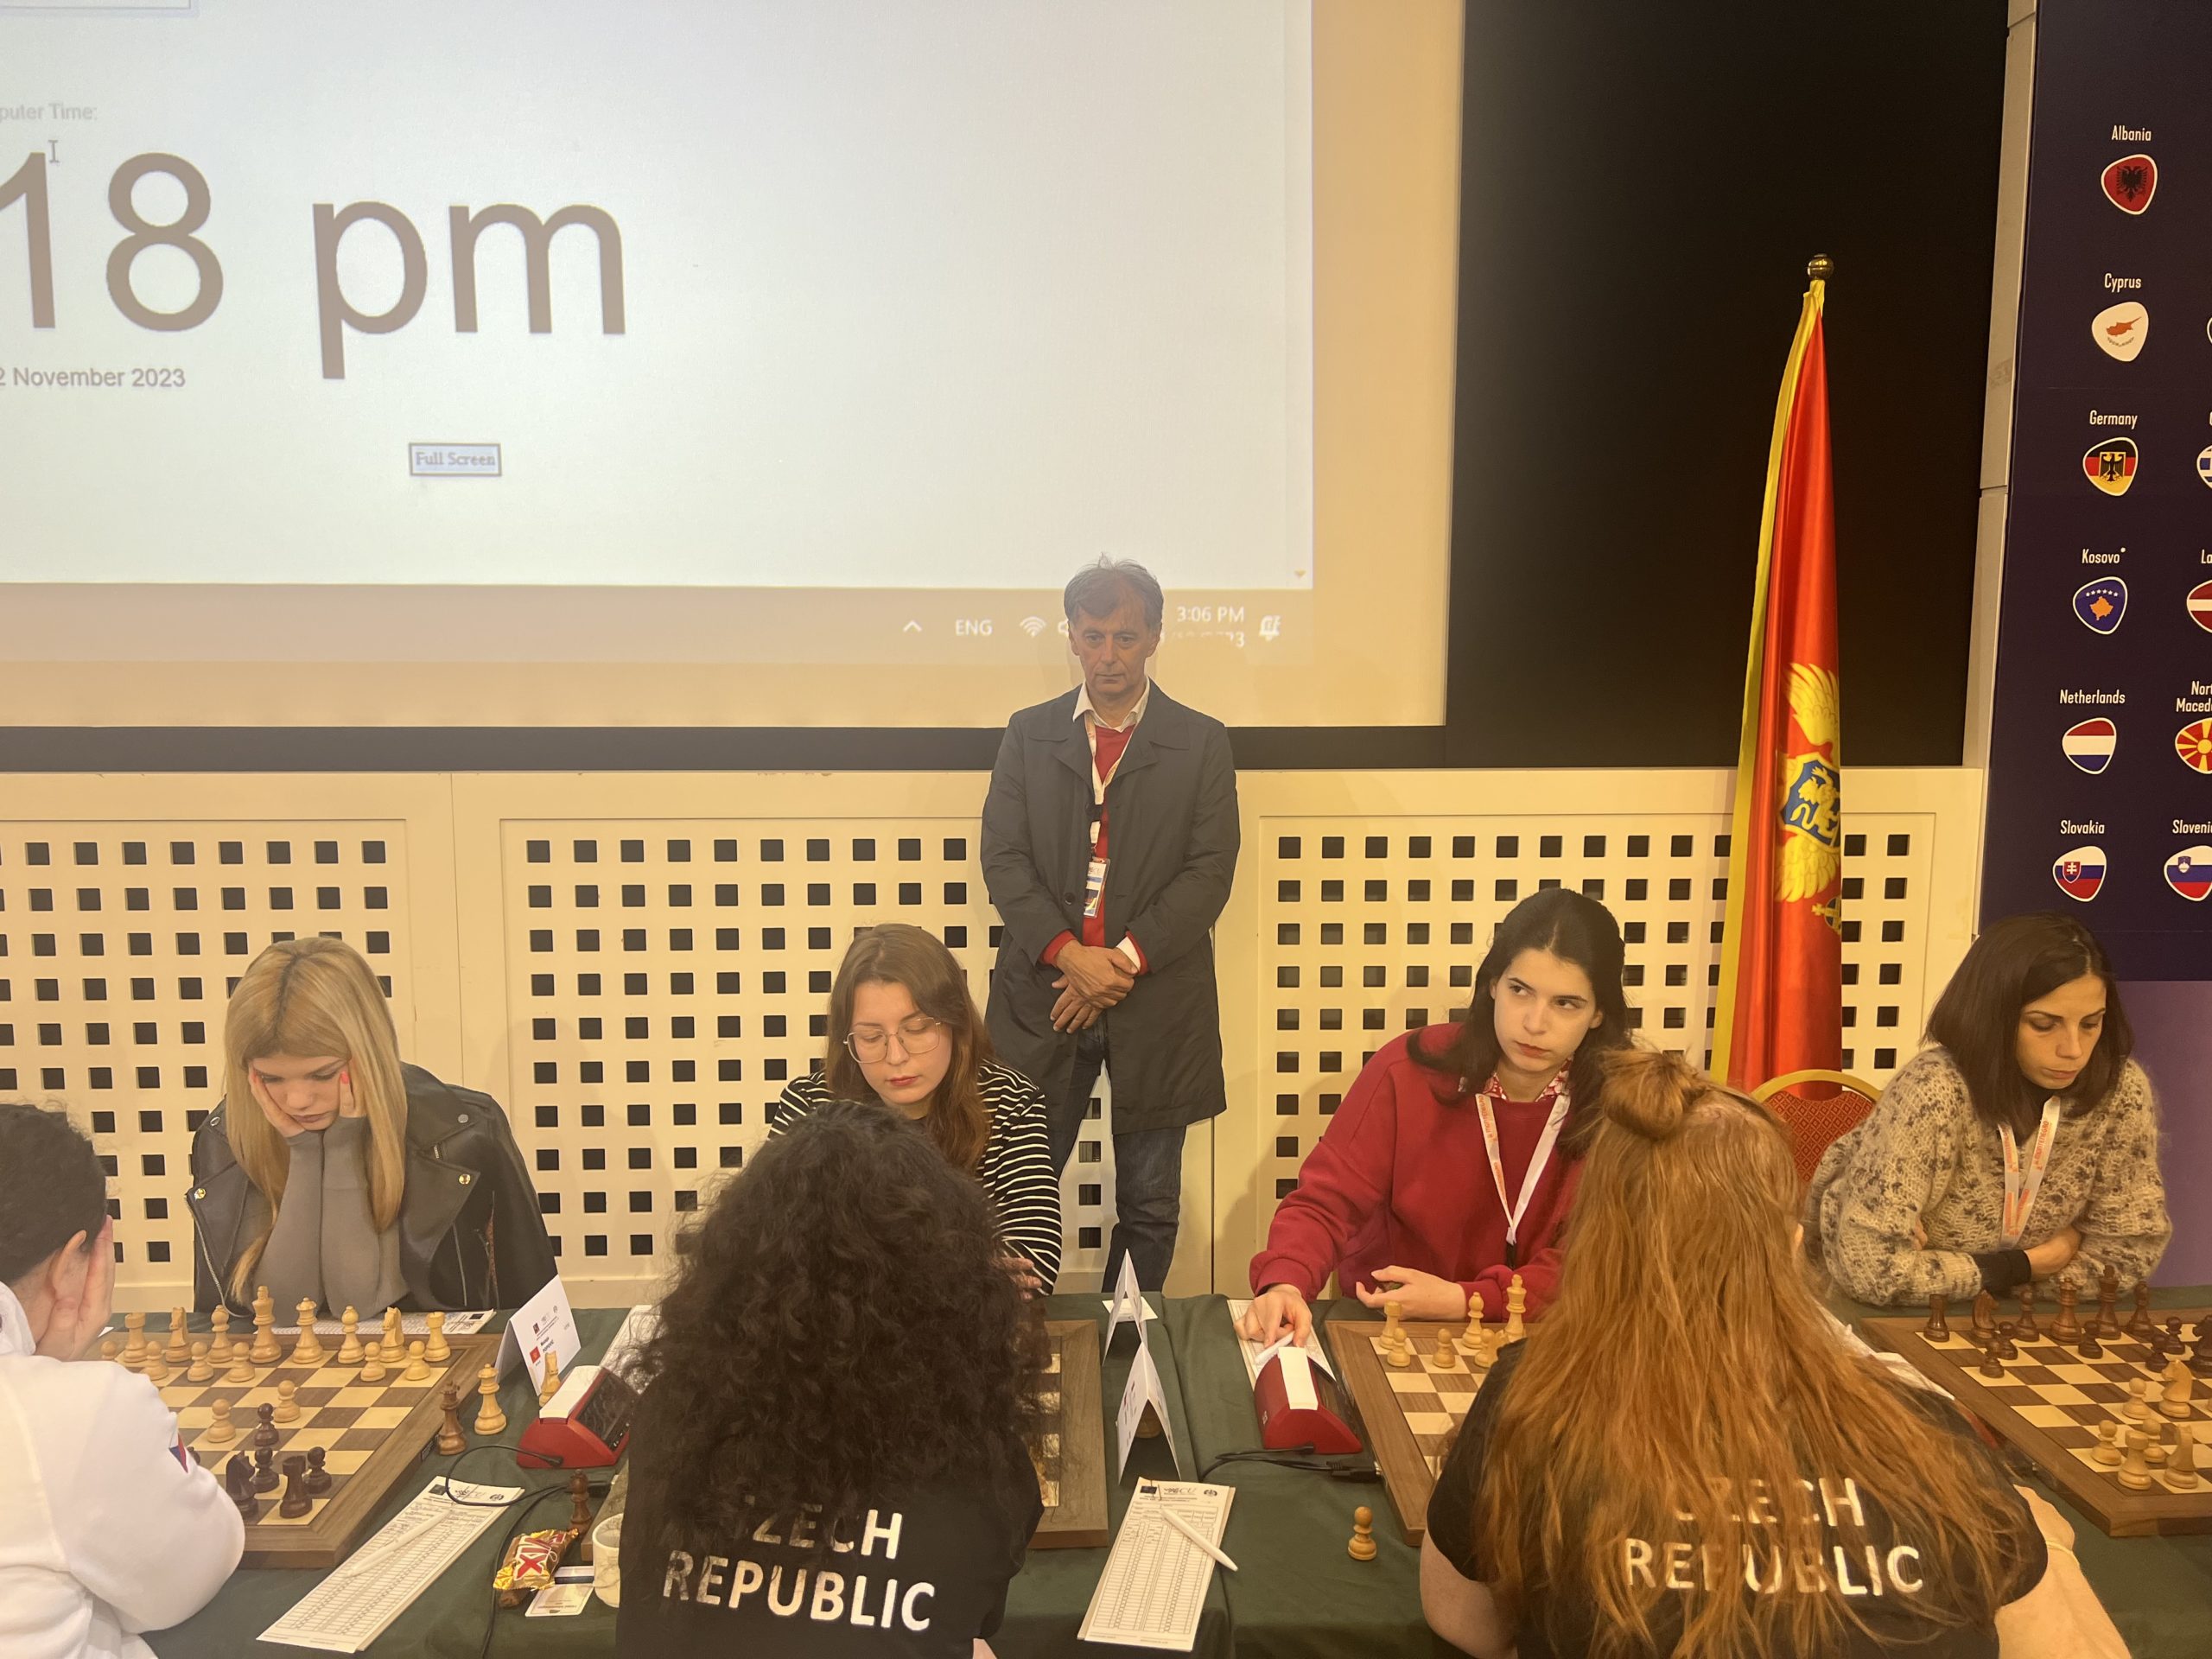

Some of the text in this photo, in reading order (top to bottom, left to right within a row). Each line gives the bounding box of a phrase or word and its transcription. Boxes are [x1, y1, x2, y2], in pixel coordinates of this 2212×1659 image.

[48, 102, 98, 121] Time:
[2111, 125, 2152, 142] Albania
[0, 152, 626, 380] 18 pm
[2104, 273, 2142, 293] Cyprus
[13, 367, 125, 386] November
[131, 368, 186, 387] 2023
[2089, 410, 2138, 429] Germany
[416, 451, 496, 466] Full Screen
[1177, 606, 1245, 622] 3:06 PM
[956, 619, 994, 637] ENG
[2060, 689, 2126, 704] Netherlands
[2176, 697, 2212, 712] Maced
[2060, 820, 2105, 835] Slovakia
[2172, 819, 2212, 835] Sloveni
[747, 1497, 903, 1560] ZECH
[663, 1549, 935, 1631] REPUBLIC
